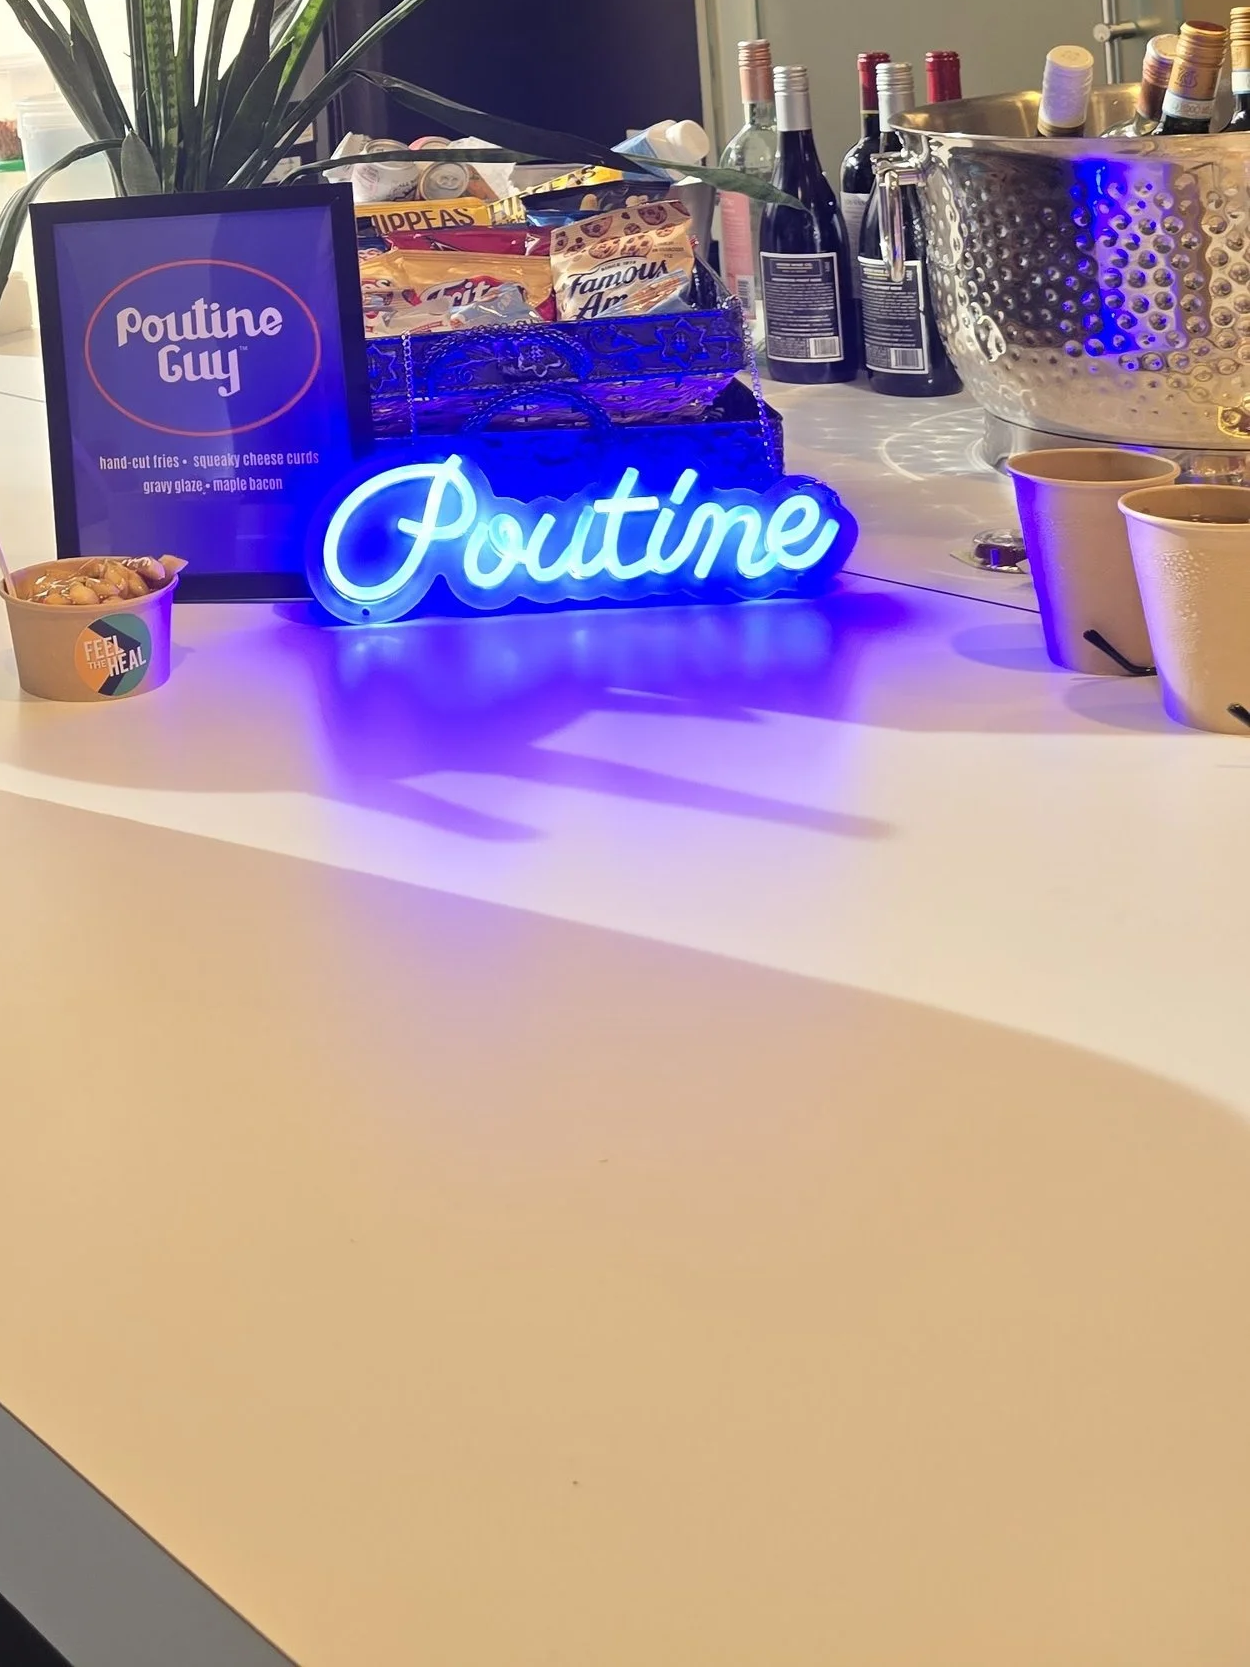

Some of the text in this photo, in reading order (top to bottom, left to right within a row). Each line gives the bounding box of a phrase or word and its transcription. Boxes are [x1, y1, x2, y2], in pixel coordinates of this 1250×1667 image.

[421, 278, 492, 308] Frit
[568, 259, 669, 298] Famous
[574, 291, 629, 320] Am
[116, 297, 283, 347] Poutine
[158, 344, 241, 397] Guy
[99, 451, 319, 470] hand-cut fries squeaky cheese curds
[143, 477, 283, 494] gravy glaze maple bacon
[323, 454, 840, 602] Poutine
[83, 635, 125, 662] FEEL
[87, 646, 146, 677] THE HEAL
